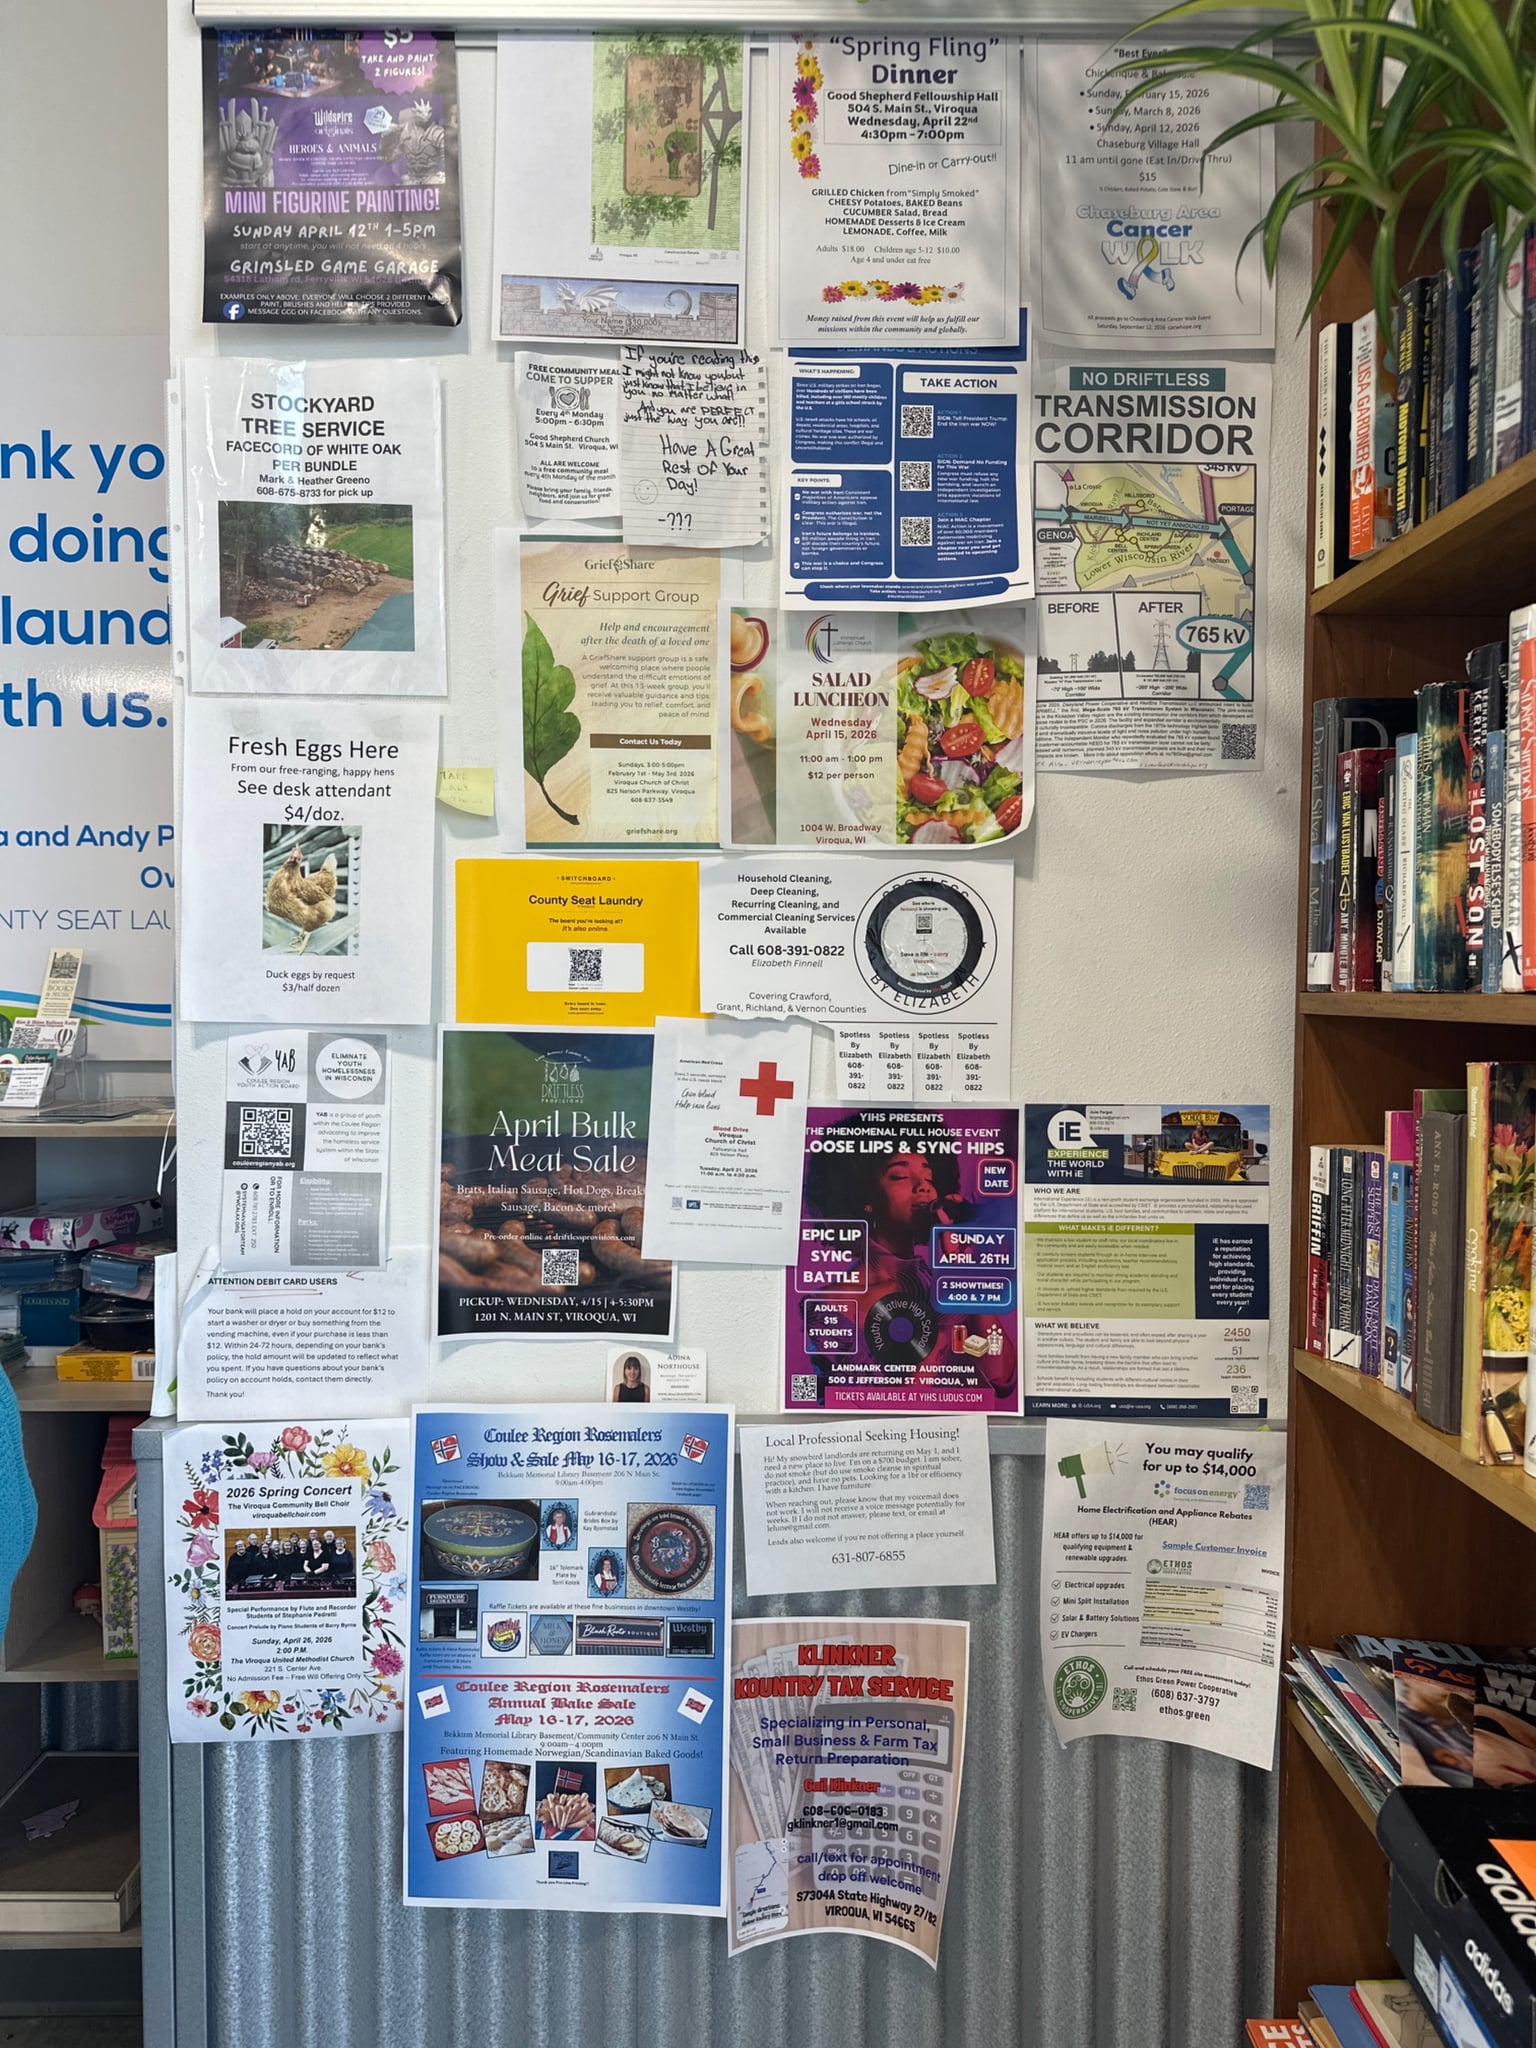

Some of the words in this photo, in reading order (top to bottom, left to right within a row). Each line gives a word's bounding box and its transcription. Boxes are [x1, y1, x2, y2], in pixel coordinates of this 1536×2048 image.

[872, 63, 957, 83] Dinner
[828, 91, 857, 102] Good
[859, 91, 912, 105] Shepherd
[914, 91, 974, 104] Fellowship
[976, 92, 999, 102] Hall
[847, 115, 919, 129] Wednesday,
[921, 115, 951, 129] April
[1096, 138, 1145, 150] Chaseburg
[1147, 139, 1178, 150] Village
[1181, 138, 1199, 148] Hall
[928, 161, 938, 169] or
[1138, 171, 1156, 182] $15
[225, 187, 266, 213] MINI
[273, 190, 349, 213] FIGURINE
[356, 187, 440, 212] PAINTING!
[233, 224, 292, 238] SUNDAY
[298, 224, 342, 239] APRIL
[1106, 220, 1193, 239] Cancer
[228, 259, 314, 276] GRIMSLED
[320, 259, 366, 274] GAME
[374, 258, 441, 276] GARAGE
[919, 377, 950, 387] TAKE
[953, 378, 997, 388] ACTION
[1082, 371, 1107, 385] NO
[1113, 372, 1209, 386] DRIFTLESS
[1357, 359, 1371, 394] LISA
[251, 392, 374, 413] STOCKYARD
[1034, 394, 1255, 419] TRANSMISSION
[241, 417, 294, 435] TREE
[302, 420, 384, 438] SERVICE
[1356, 398, 1371, 464] GARDNER
[1398, 402, 1409, 466] MIDTOWN
[226, 440, 302, 455] FACECORD
[306, 444, 323, 455] OF
[326, 443, 368, 454] WHITE
[372, 443, 401, 454] OAK
[659, 433, 697, 456] Have
[705, 438, 716, 458] A
[719, 435, 754, 457] Great
[1035, 422, 1253, 455] CORRIDOR
[272, 459, 300, 471] PER
[304, 460, 357, 472] BUNDLE
[662, 459, 691, 478] Rest
[722, 462, 748, 476] Your
[256, 486, 321, 497] 608-675-8733
[322, 488, 336, 496] for
[338, 488, 358, 498] pick
[360, 489, 373, 498] up
[665, 476, 697, 496] Day!
[1397, 467, 1408, 511] NORTH
[1221, 505, 1255, 513] PORTAGE
[1038, 531, 1074, 540] GENOA
[542, 580, 590, 608] Grief
[593, 589, 650, 603] Support
[654, 589, 699, 604] Group
[1047, 602, 1099, 613] BEFORE
[1138, 601, 1183, 613] AFTER
[599, 621, 620, 633] Help
[622, 622, 640, 631] and
[642, 625, 709, 634] encouragement
[1184, 625, 1219, 646] 765
[1223, 626, 1248, 645] kV
[812, 672, 871, 686] SALAD
[793, 692, 888, 706] LUNCHEON
[81, 692, 167, 728] us.
[810, 717, 874, 729] Wednesday
[1473, 690, 1483, 757] KERIK
[805, 729, 831, 740] April
[834, 729, 847, 739] 15,
[850, 729, 877, 739] 2026
[229, 736, 287, 756] Fresh
[296, 738, 342, 762] Eggs
[350, 740, 398, 758] Here
[807, 770, 823, 779] $12
[843, 772, 874, 780] person
[237, 779, 267, 794] See
[272, 781, 310, 796] desk
[315, 783, 391, 797] attendant
[281, 804, 344, 823] $4/doz.
[17, 823, 69, 847] and
[76, 824, 150, 852] Andy
[1469, 800, 1486, 874] LOST
[528, 894, 568, 906] County
[570, 895, 595, 907] Seat
[598, 895, 643, 907] Laundry
[57, 909, 122, 930] SEAT
[1467, 886, 1485, 947] SON
[729, 944, 753, 955] Call
[757, 944, 844, 956] 608-391-0822
[265, 969, 288, 978] Duck
[290, 972, 310, 980] eggs
[312, 970, 322, 980] by
[324, 971, 354, 980] request
[489, 1109, 559, 1144] April
[571, 1110, 635, 1138] Bulk
[859, 1140, 893, 1153] LIPS
[898, 1140, 911, 1153] &
[916, 1140, 961, 1153] SYNC
[967, 1141, 1004, 1154] HIPS
[1047, 1149, 1109, 1159] EXPERIENCE
[487, 1143, 562, 1171] Meat
[570, 1144, 635, 1172] Sale
[1047, 1160, 1066, 1169] THE
[1068, 1160, 1104, 1169] WORLD
[1310, 1192, 1323, 1256] GRIFFIN
[802, 1228, 834, 1240] EPIC
[839, 1229, 861, 1241] LIP
[950, 1233, 1004, 1244] SUNDAY
[810, 1249, 852, 1262] SYNC
[937, 1253, 975, 1266] APRIL
[980, 1252, 1009, 1264] 26TH
[1468, 1228, 1482, 1292] Cooking
[207, 1277, 254, 1285] ATTENTION
[282, 1277, 307, 1285] CARD
[309, 1277, 337, 1285] USERS
[803, 1270, 859, 1283] BATTLE
[1224, 1327, 1250, 1336] 2450
[483, 1428, 528, 1442] Coulee
[531, 1427, 580, 1445] Region
[583, 1426, 662, 1441] Rosemalers
[765, 1434, 794, 1447] Local
[798, 1430, 862, 1445] Professional
[865, 1428, 907, 1443] Seeking
[910, 1427, 959, 1441] Housing!
[1145, 1442, 1170, 1454] You
[1174, 1447, 1203, 1459] may
[1206, 1447, 1253, 1462] qualify
[1142, 1459, 1161, 1471] for
[1165, 1464, 1181, 1475] up
[1185, 1463, 1198, 1473] to
[1202, 1461, 1256, 1477] $14,000
[226, 1487, 255, 1498] 2026
[258, 1486, 299, 1499] Spring
[303, 1485, 352, 1495] Concert
[831, 1550, 905, 1563] 631-807-6855
[798, 1644, 896, 1666] KLINKNER
[734, 1675, 824, 1700] KOUNTRY
[827, 1676, 864, 1697] TAX
[868, 1676, 954, 1702] SERVICE
[1151, 1688, 1173, 1700] (608)
[1176, 1691, 1219, 1707] 637-3797
[1159, 1705, 1210, 1721] ethos.green
[1465, 1939, 1514, 2015] adidas
